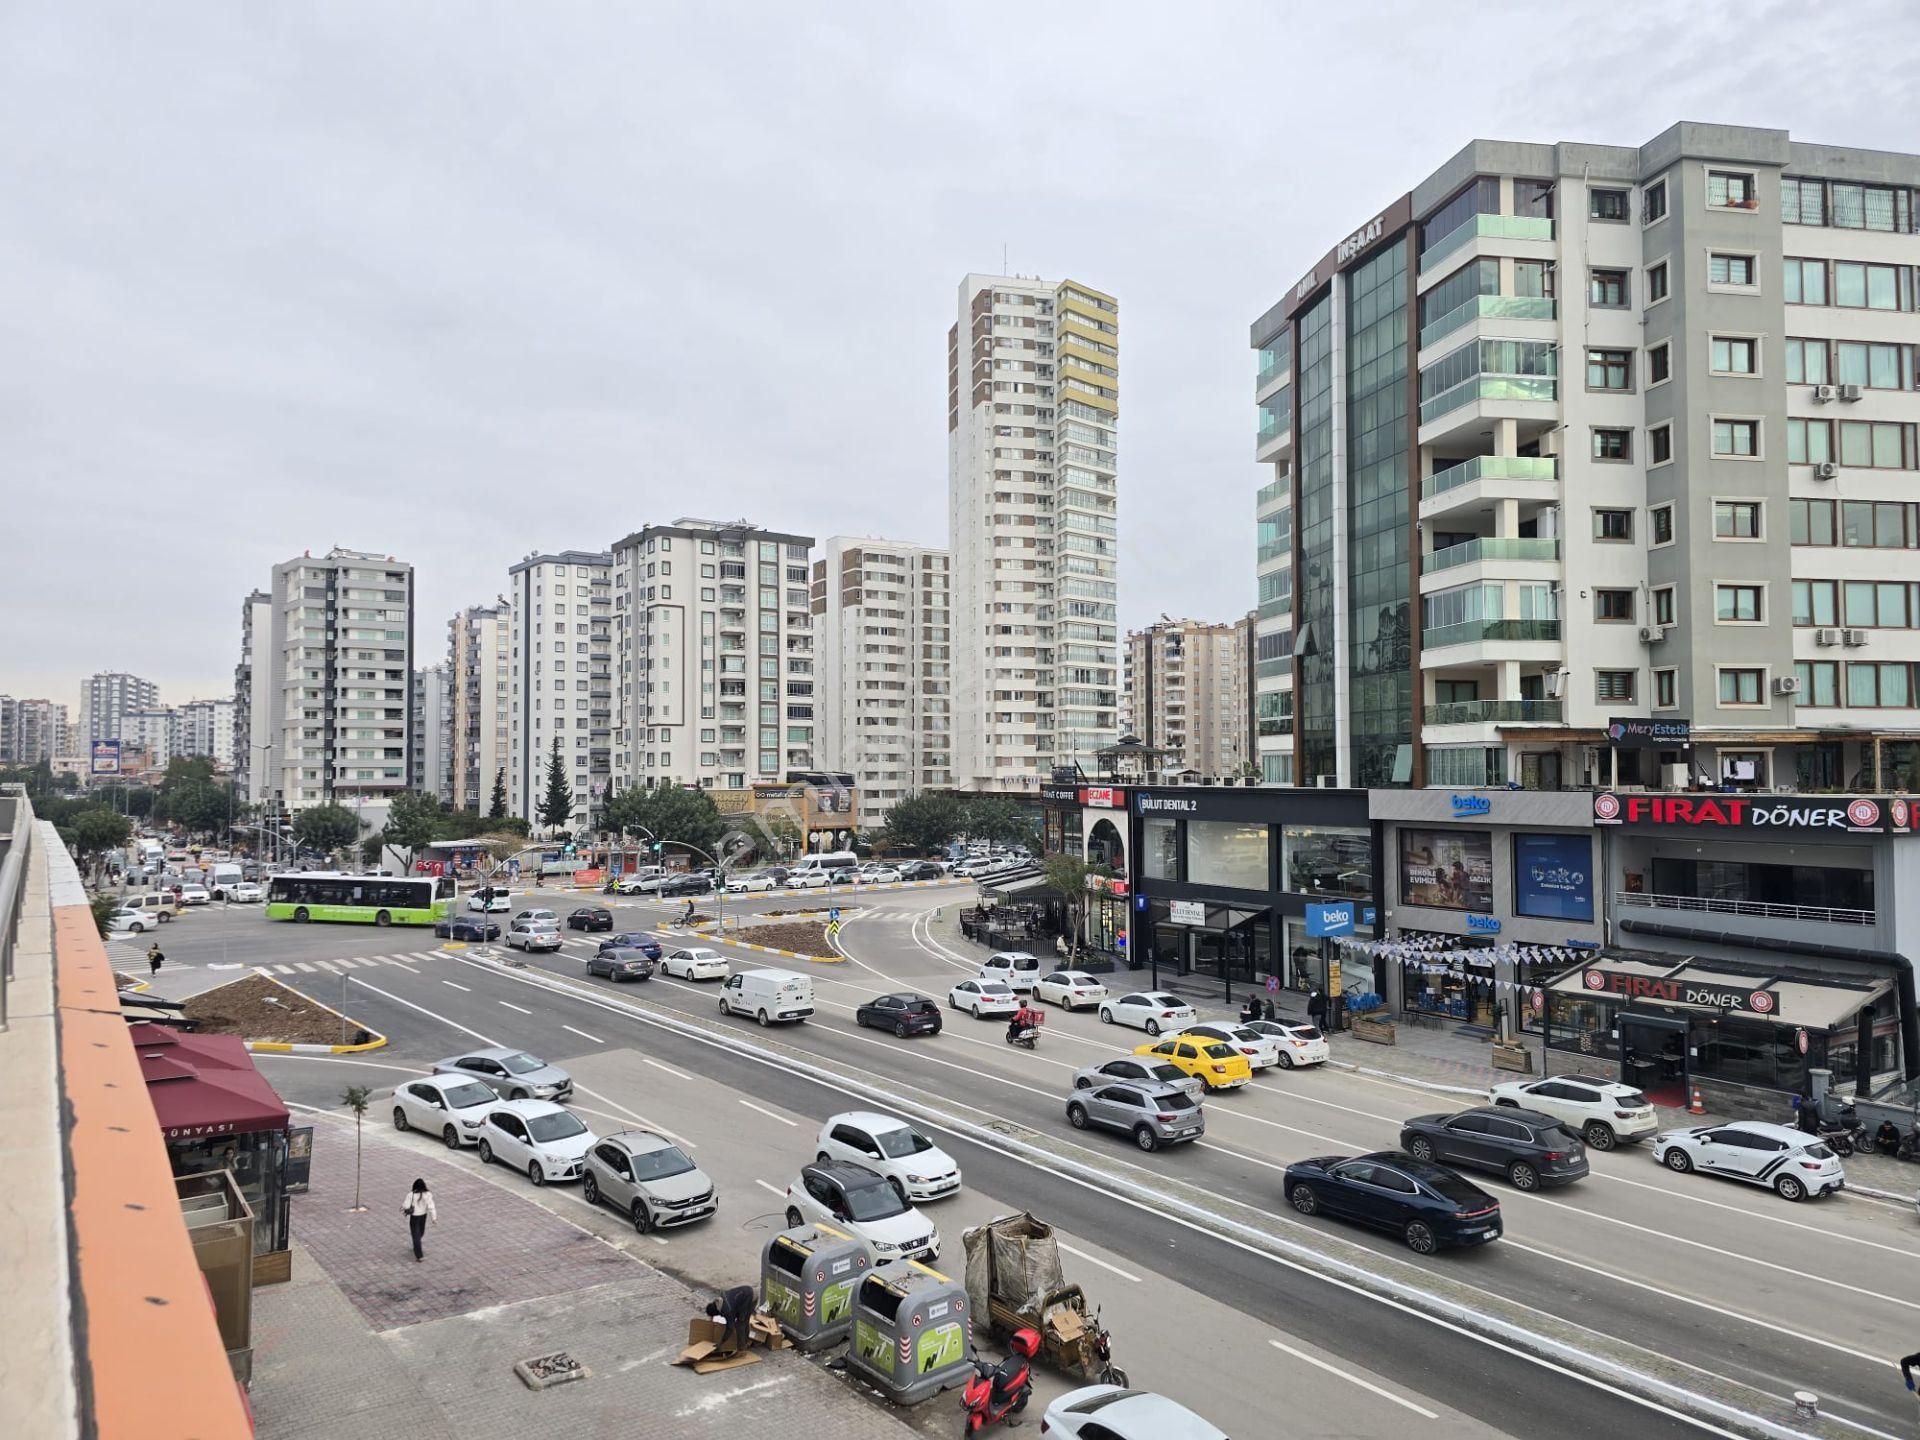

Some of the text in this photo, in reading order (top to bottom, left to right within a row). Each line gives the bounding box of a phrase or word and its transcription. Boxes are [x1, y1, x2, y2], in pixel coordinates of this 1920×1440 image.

[1337, 216, 1385, 264] İNŞAAT
[1088, 789, 1111, 801] ECZANE
[1142, 798, 1197, 811] BULUT DENTAL 2
[1452, 795, 1490, 810] beko
[1627, 797, 1848, 829] FIRAT DÖNER
[1323, 909, 1349, 923] beko
[1467, 915, 1501, 929] beko
[1609, 974, 1743, 1010] FIRAT DÖNER
